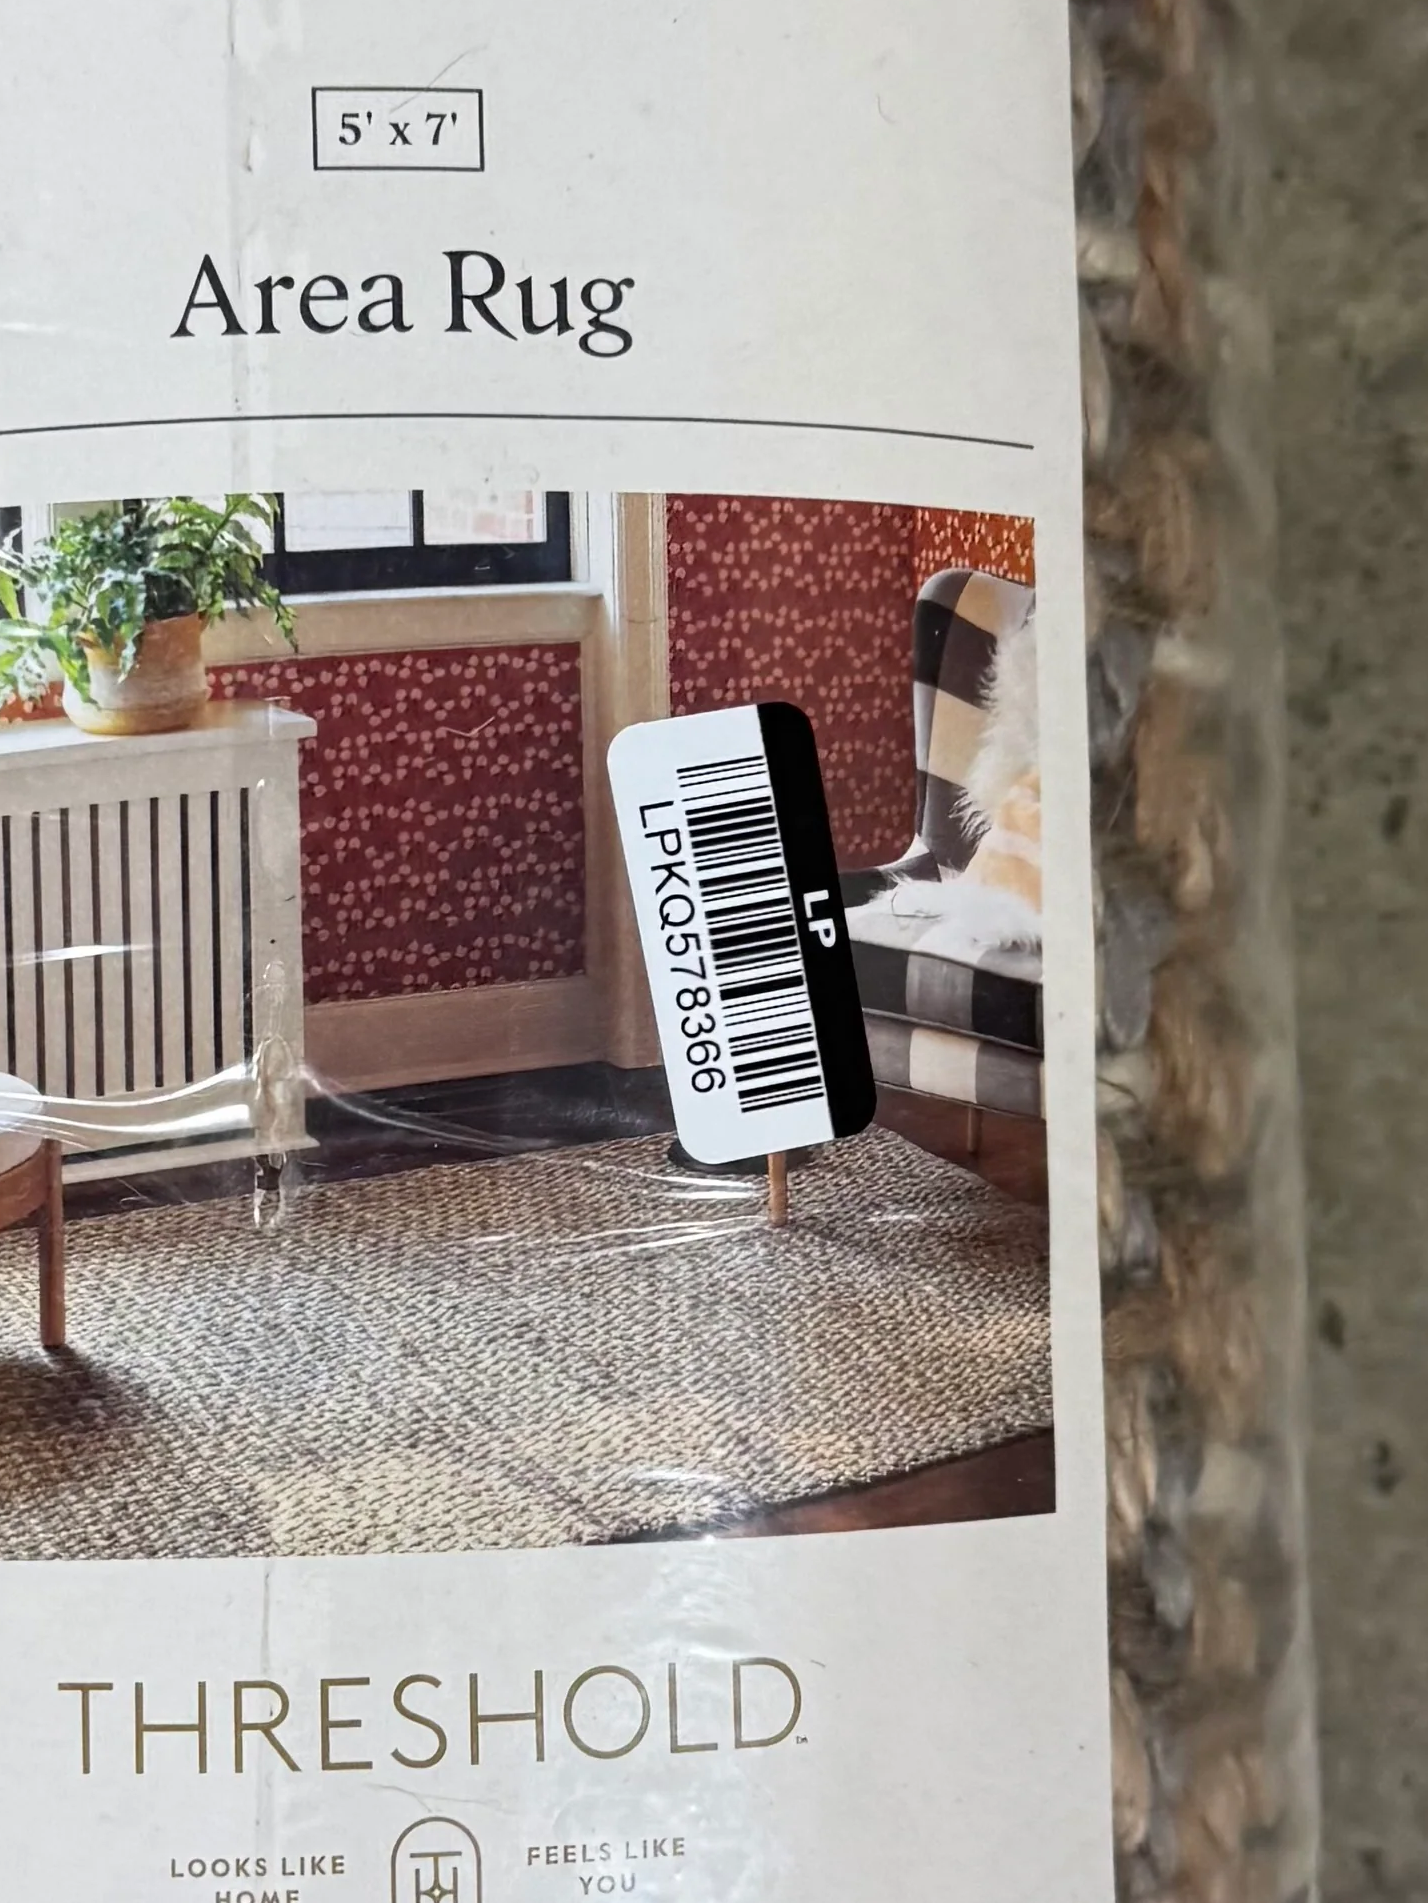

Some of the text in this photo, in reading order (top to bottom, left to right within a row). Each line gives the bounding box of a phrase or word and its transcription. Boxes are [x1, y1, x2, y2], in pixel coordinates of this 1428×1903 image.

[338, 110, 458, 146] 5' x 7'
[170, 250, 636, 360] Area Rug
[802, 888, 837, 949] LP
[638, 800, 727, 1094] LPKQ578366
[56, 1656, 803, 1775] THRESHOLD
[170, 1854, 346, 1880] LOOKS LIKE
[526, 1836, 688, 1867] FEELS LIKE
[578, 1872, 638, 1897] YOU
